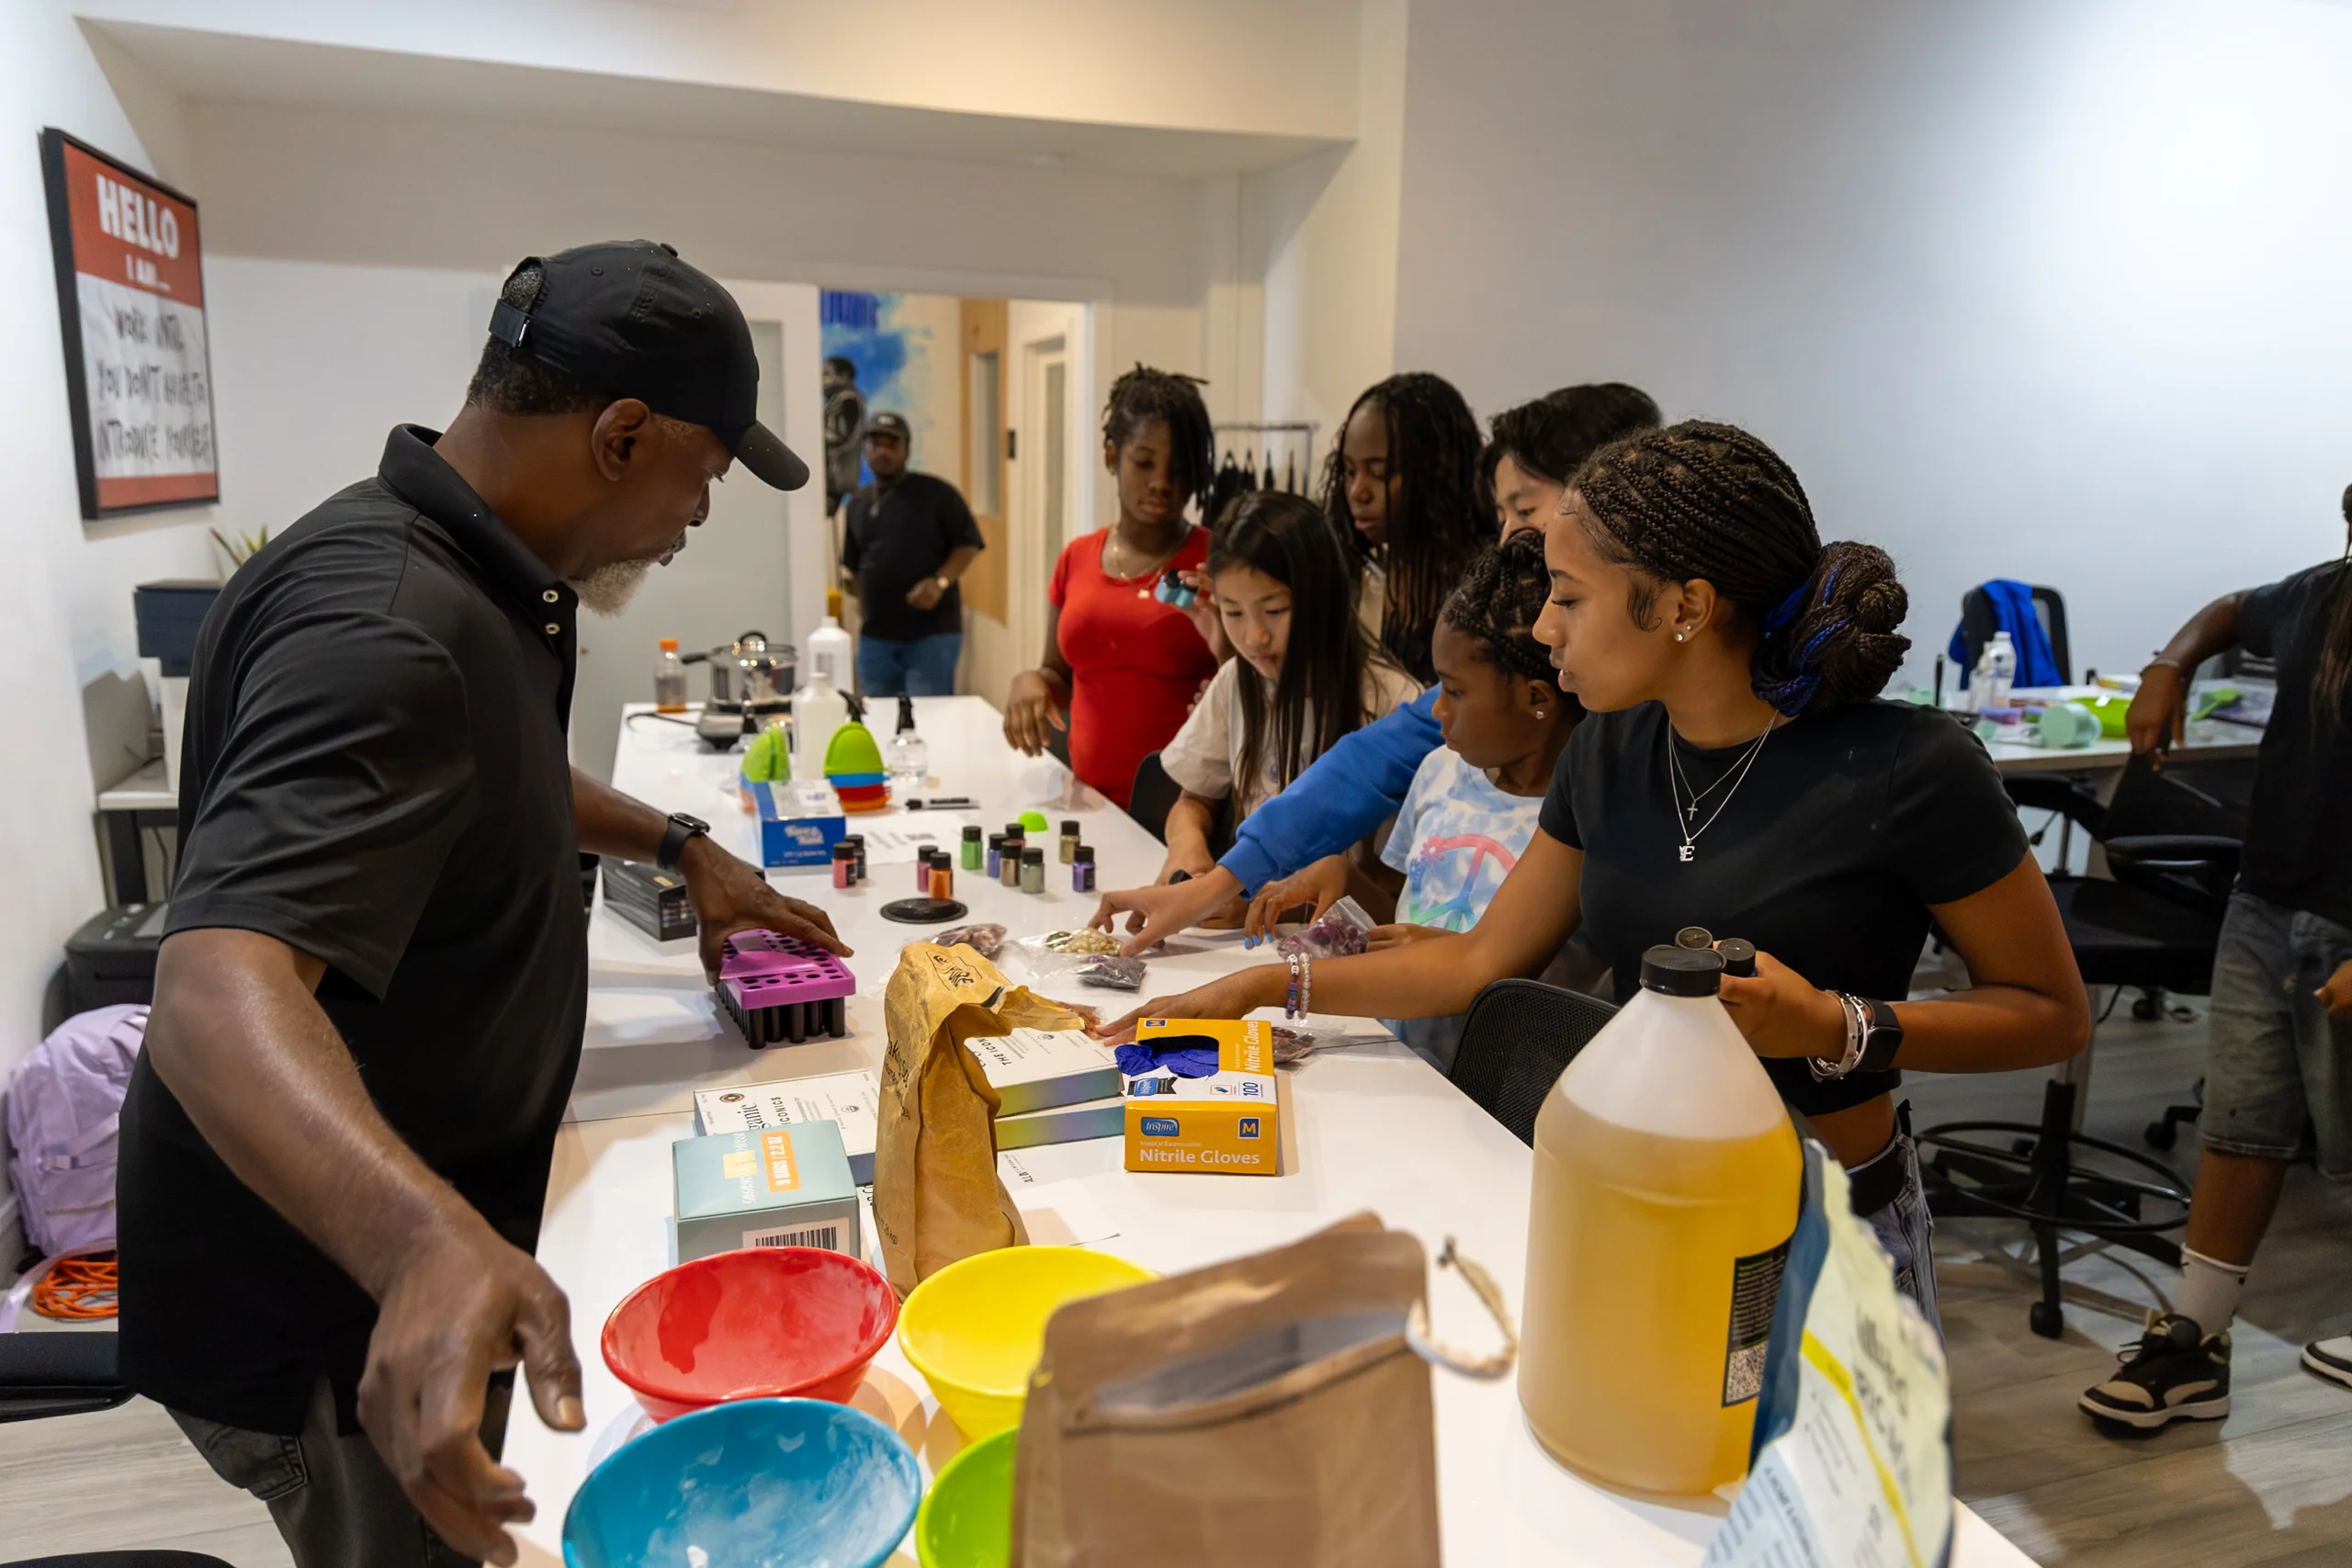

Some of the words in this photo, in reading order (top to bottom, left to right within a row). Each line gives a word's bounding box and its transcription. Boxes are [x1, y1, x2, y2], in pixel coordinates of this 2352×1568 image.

[96, 172, 179, 260] HELLO
[1243, 1021, 1260, 1044] Gloves
[993, 1053, 1012, 1066] THE
[1244, 1045, 1261, 1072] Nitrile
[1242, 1081, 1259, 1097] 100
[771, 1096, 792, 1124] ICONICS
[1146, 1121, 1175, 1133] Inspire
[1242, 1122, 1256, 1134] M
[1139, 1148, 1195, 1163] Nitrile
[1200, 1150, 1261, 1165] Gloves
